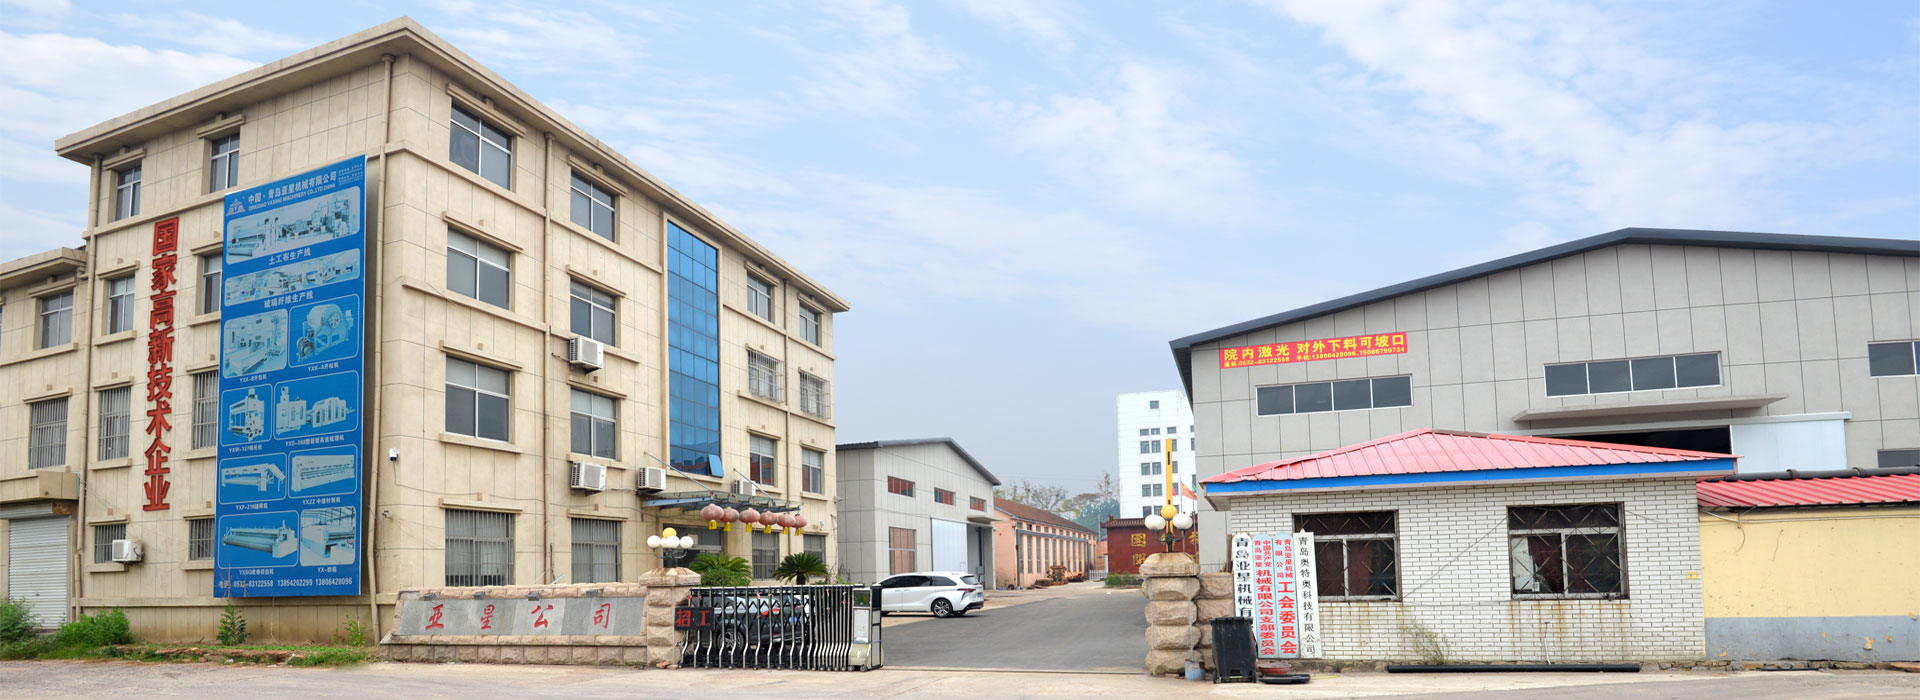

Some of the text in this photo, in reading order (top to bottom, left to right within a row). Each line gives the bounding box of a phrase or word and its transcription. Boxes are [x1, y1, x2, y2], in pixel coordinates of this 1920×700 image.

[268, 247, 312, 265] 土工布生产线
[263, 290, 314, 309] 玻璃纤维生产线
[1223, 334, 1404, 361] 院内激光 对外下料可坡口
[143, 216, 179, 511] 国家高新技术企业
[1254, 539, 1263, 568] 青岛亚星
[1263, 539, 1273, 568] 中国共产党
[1274, 539, 1285, 579] 有限公司
[1284, 538, 1294, 579] 青岛亚星机械
[277, 578, 313, 587] 13854202299
[315, 577, 353, 586] 13806428096
[1298, 536, 1316, 655] 青岛奥特奥科技有限公司
[676, 608, 711, 628] 招工
[1255, 569, 1276, 656] 机械有限公司支部委员会
[1277, 581, 1297, 655] 工会委员会
